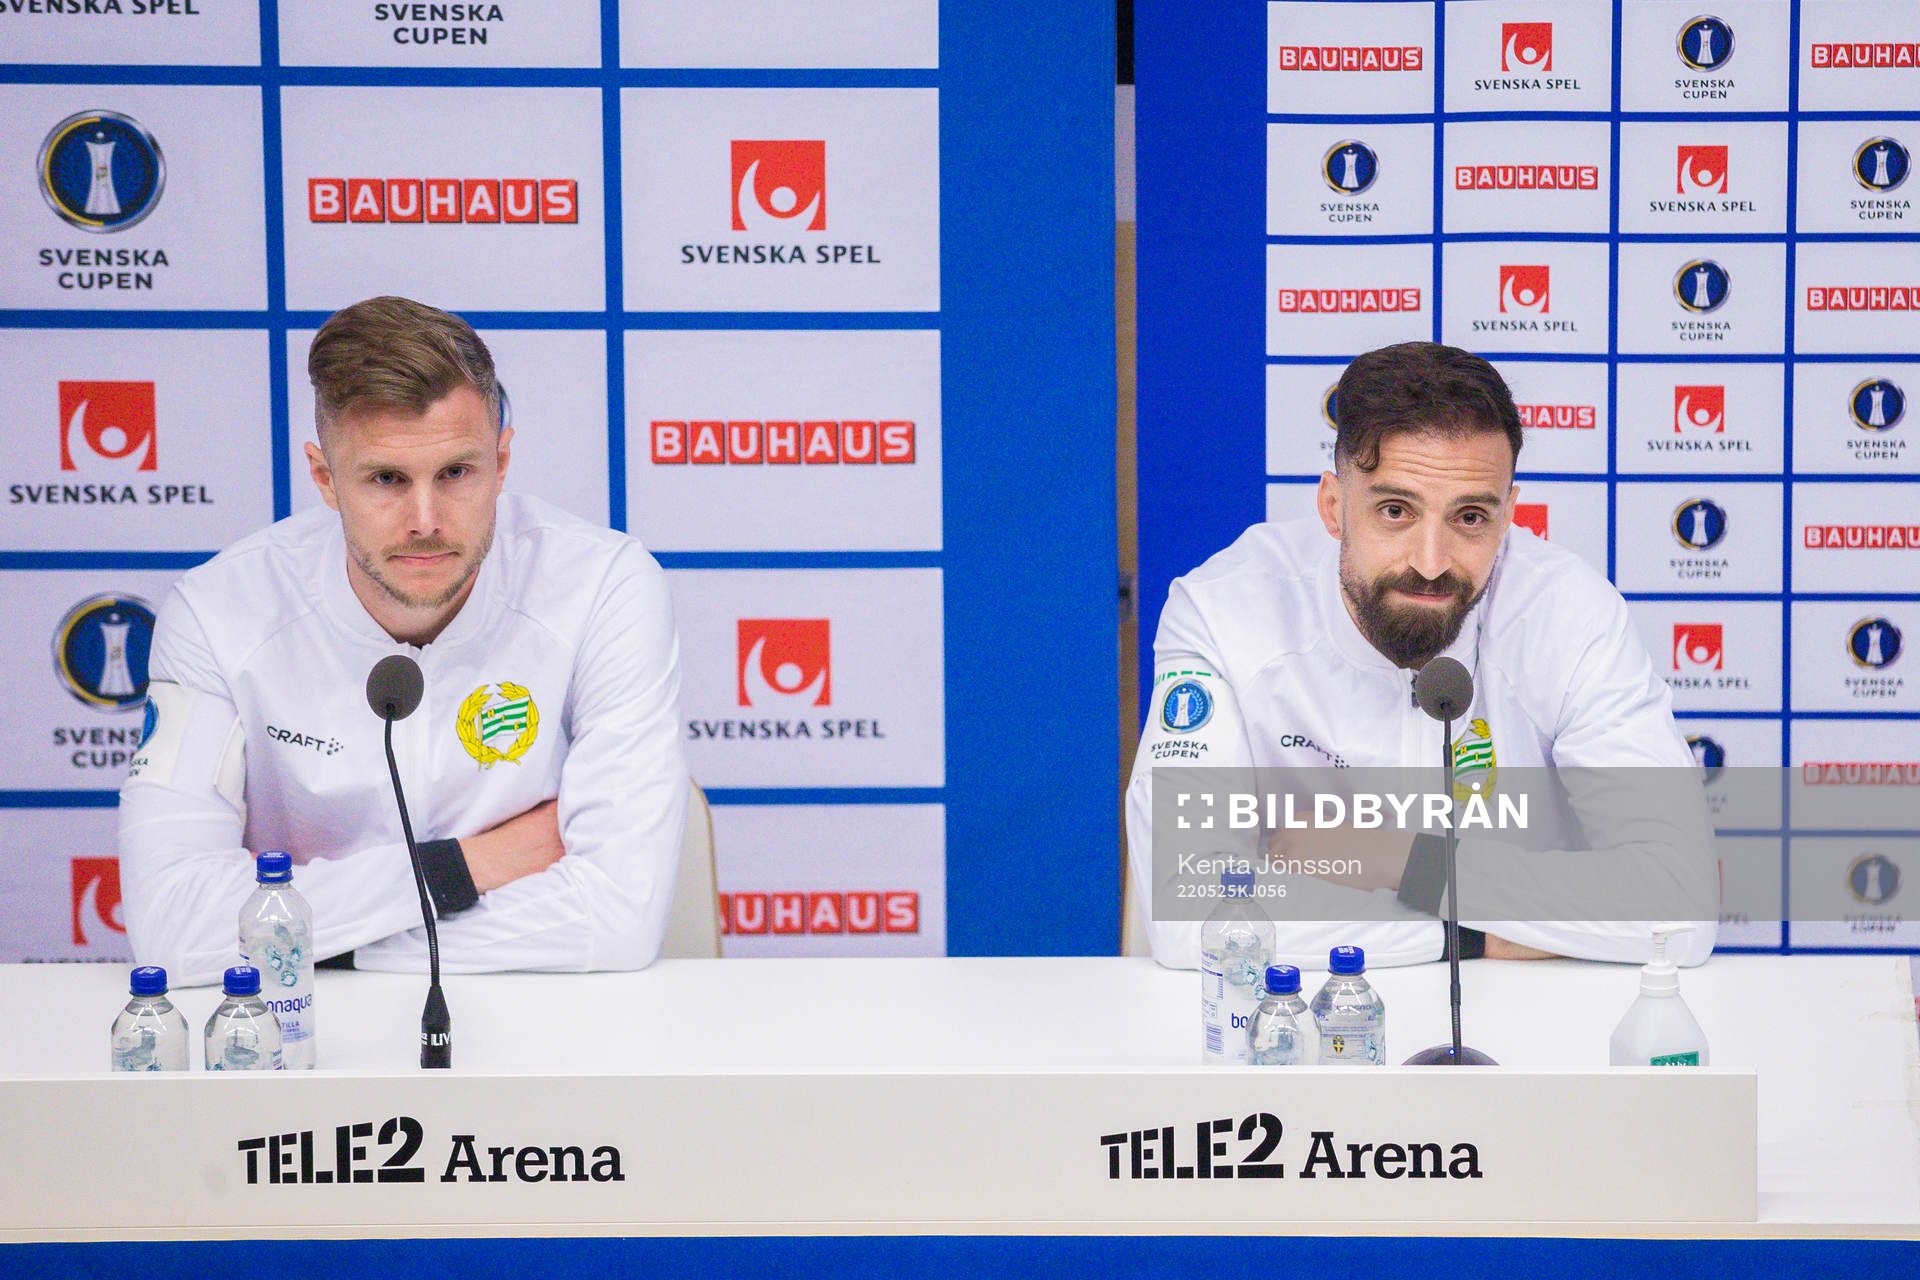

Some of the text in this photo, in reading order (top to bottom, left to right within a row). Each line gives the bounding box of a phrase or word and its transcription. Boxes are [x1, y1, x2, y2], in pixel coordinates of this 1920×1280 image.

[132, 0, 200, 15] SPEL
[374, 3, 504, 22] SVENSKA
[393, 26, 488, 45] CUPEN
[1279, 46, 1423, 71] BAUHAUS
[1810, 43, 1920, 68] BAUHA
[1474, 78, 1581, 91] SVENSKA SPEL
[1674, 79, 1735, 89] SVENSKA
[1683, 90, 1727, 99] CUPEN
[1455, 165, 1598, 190] BAUHAUS
[308, 178, 577, 224] BAUHAUS
[1320, 203, 1380, 212] SVENSKA
[1649, 201, 1757, 212] SVENSKA SPEL
[1850, 200, 1911, 209] SVENSKA
[1328, 213, 1372, 223] CUPEN
[1858, 210, 1903, 220] CUPEN
[39, 248, 169, 267] SVENSKA
[681, 244, 881, 264] SVENSKA SPEL
[57, 272, 153, 290] CUPEN
[1279, 288, 1421, 313] BAUHAUS
[1472, 320, 1578, 332] SVENSKA SPEL
[1671, 321, 1731, 331] SVENSKA
[1679, 332, 1724, 341] CUPEN
[650, 421, 915, 465] BAUHAUS
[1647, 440, 1753, 451] SVENSKA SPEL
[1847, 440, 1906, 449] SVENSKA
[1855, 451, 1899, 460] CUPEN
[9, 484, 214, 504] SVENSKA SPEL
[688, 720, 885, 740] SVENSKA SPEL
[266, 725, 326, 752] CRAFT
[1151, 740, 1209, 753] SVENSKA
[1154, 749, 1200, 760] CUPEN
[719, 892, 919, 936] UHAUS
[237, 1116, 626, 1185] TELE2 Arena
[1100, 1112, 1484, 1180] TELE2 Arena
